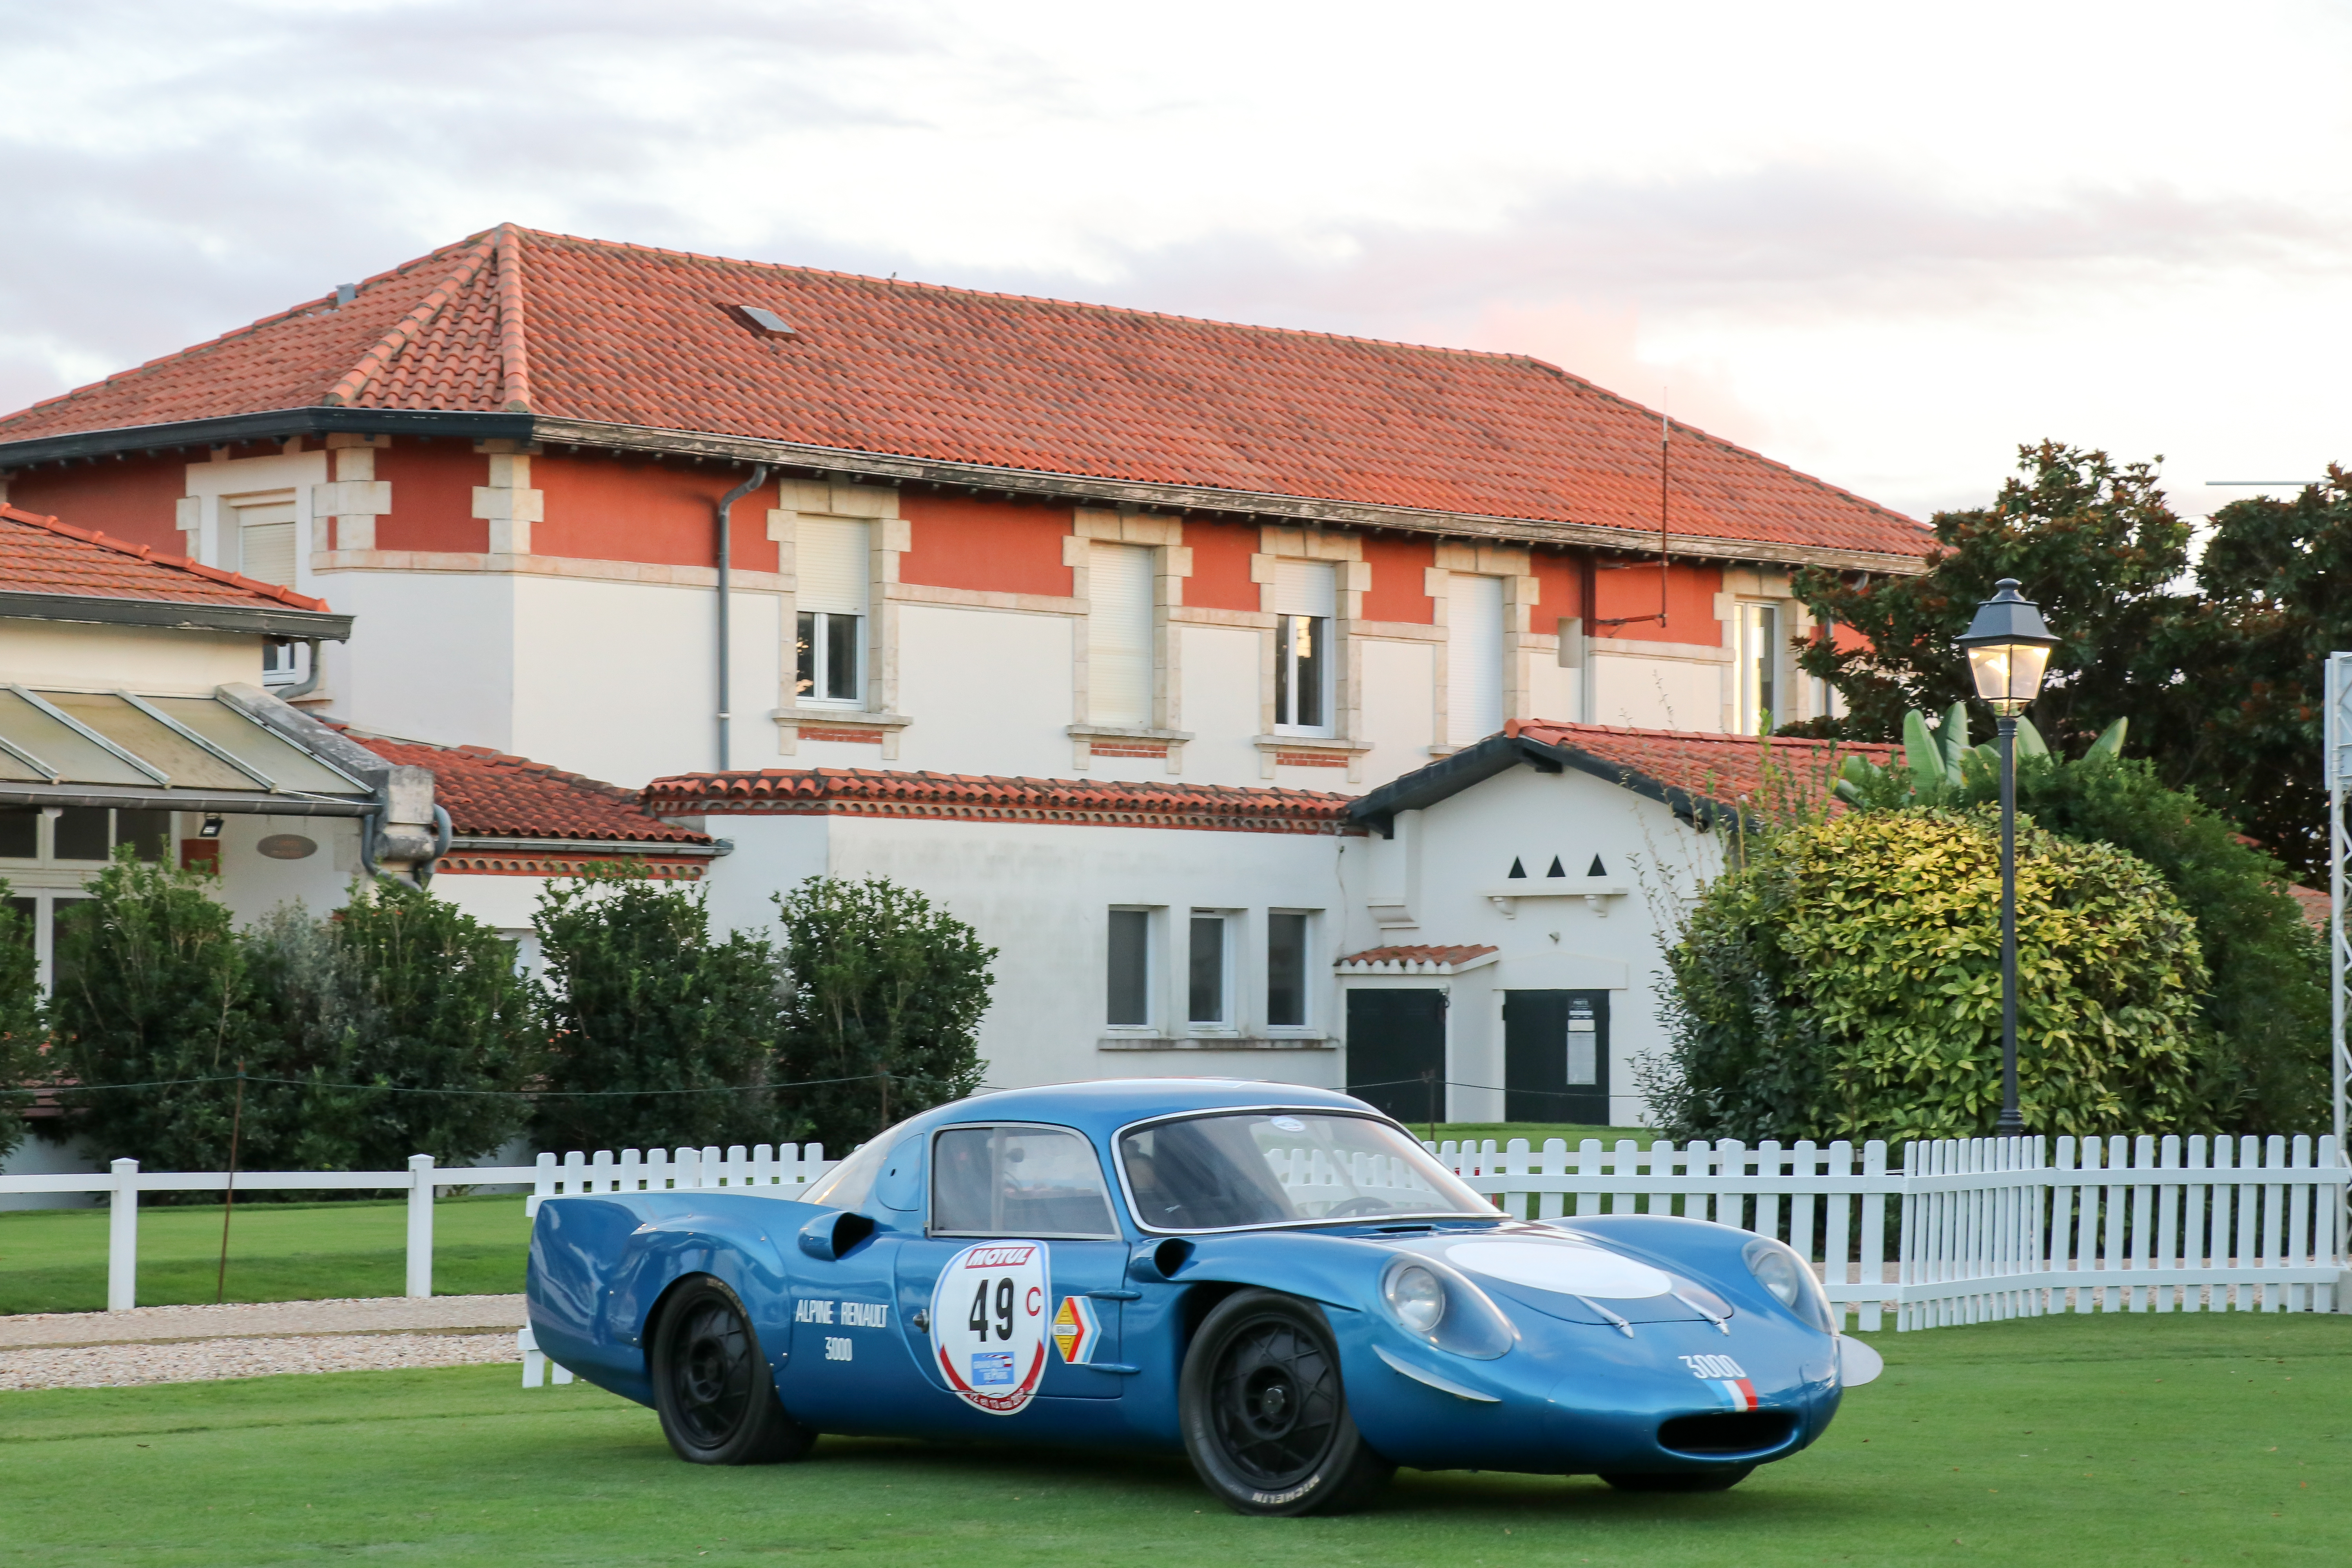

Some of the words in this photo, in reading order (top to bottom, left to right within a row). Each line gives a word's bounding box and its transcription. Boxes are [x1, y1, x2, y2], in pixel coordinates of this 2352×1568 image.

[967, 1249, 1032, 1266] MOTUL
[795, 1299, 834, 1324] ALPINE
[840, 1301, 889, 1328] RENAULT
[970, 1278, 1014, 1342] 49
[1027, 1286, 1041, 1316] C
[825, 1336, 853, 1361] 3000
[1677, 1354, 1747, 1379] 3000
[1251, 1474, 1320, 1504] MICHELIN
